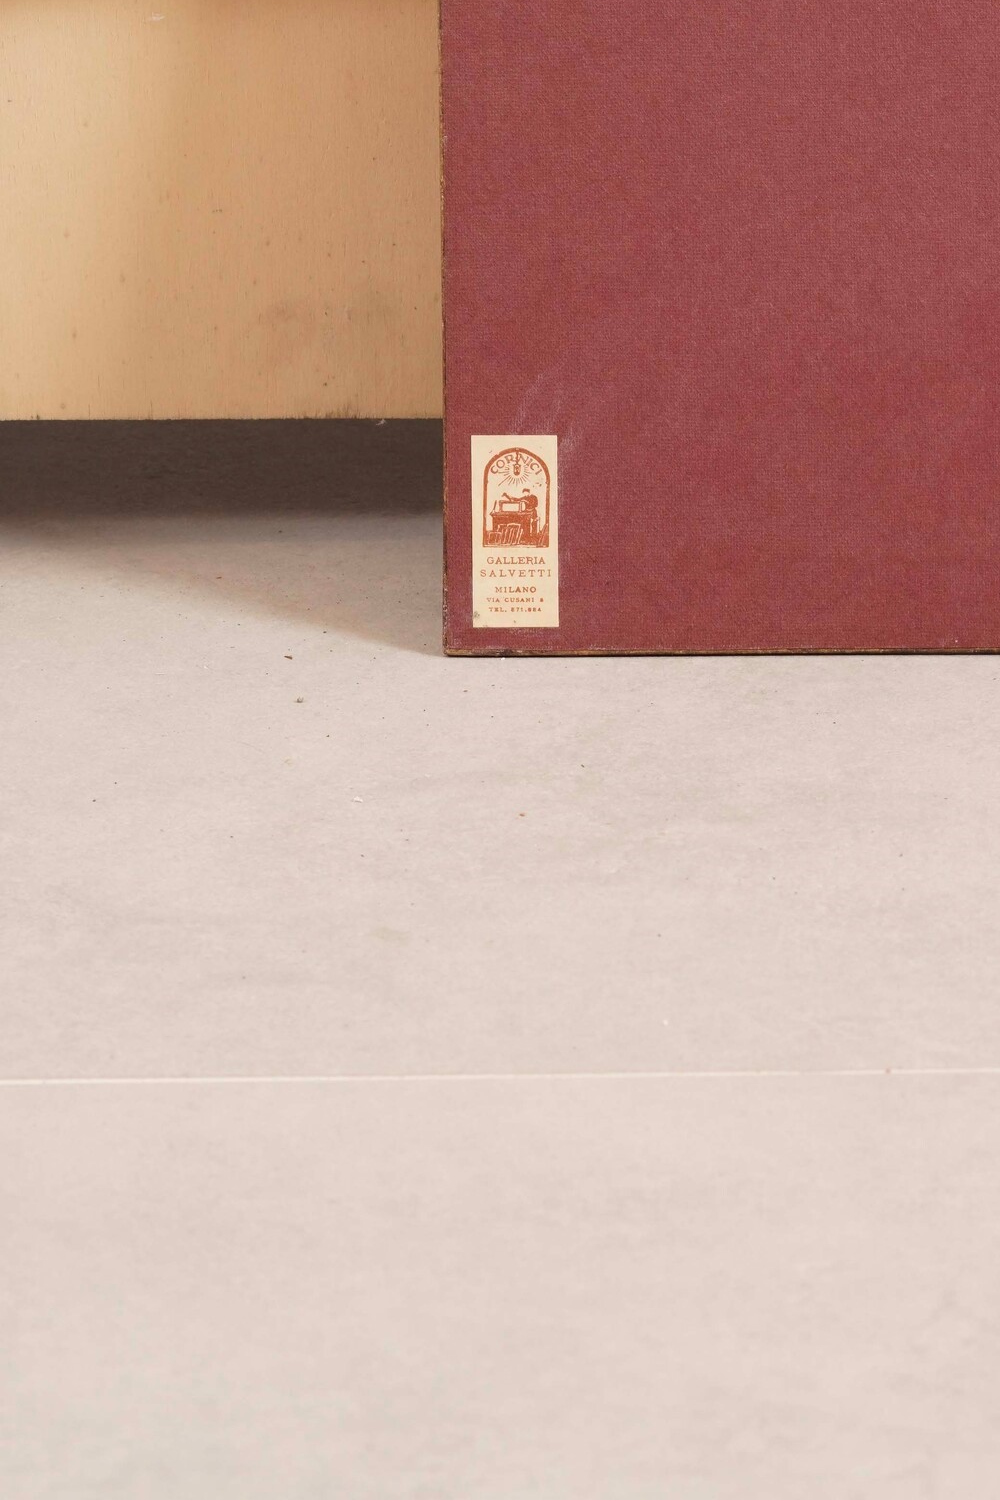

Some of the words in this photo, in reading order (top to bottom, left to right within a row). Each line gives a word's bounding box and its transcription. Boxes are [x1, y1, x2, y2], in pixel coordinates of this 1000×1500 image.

[490, 453, 543, 475] CORNICI
[486, 556, 546, 565] GALLERIA
[480, 569, 552, 578] SALVETTI
